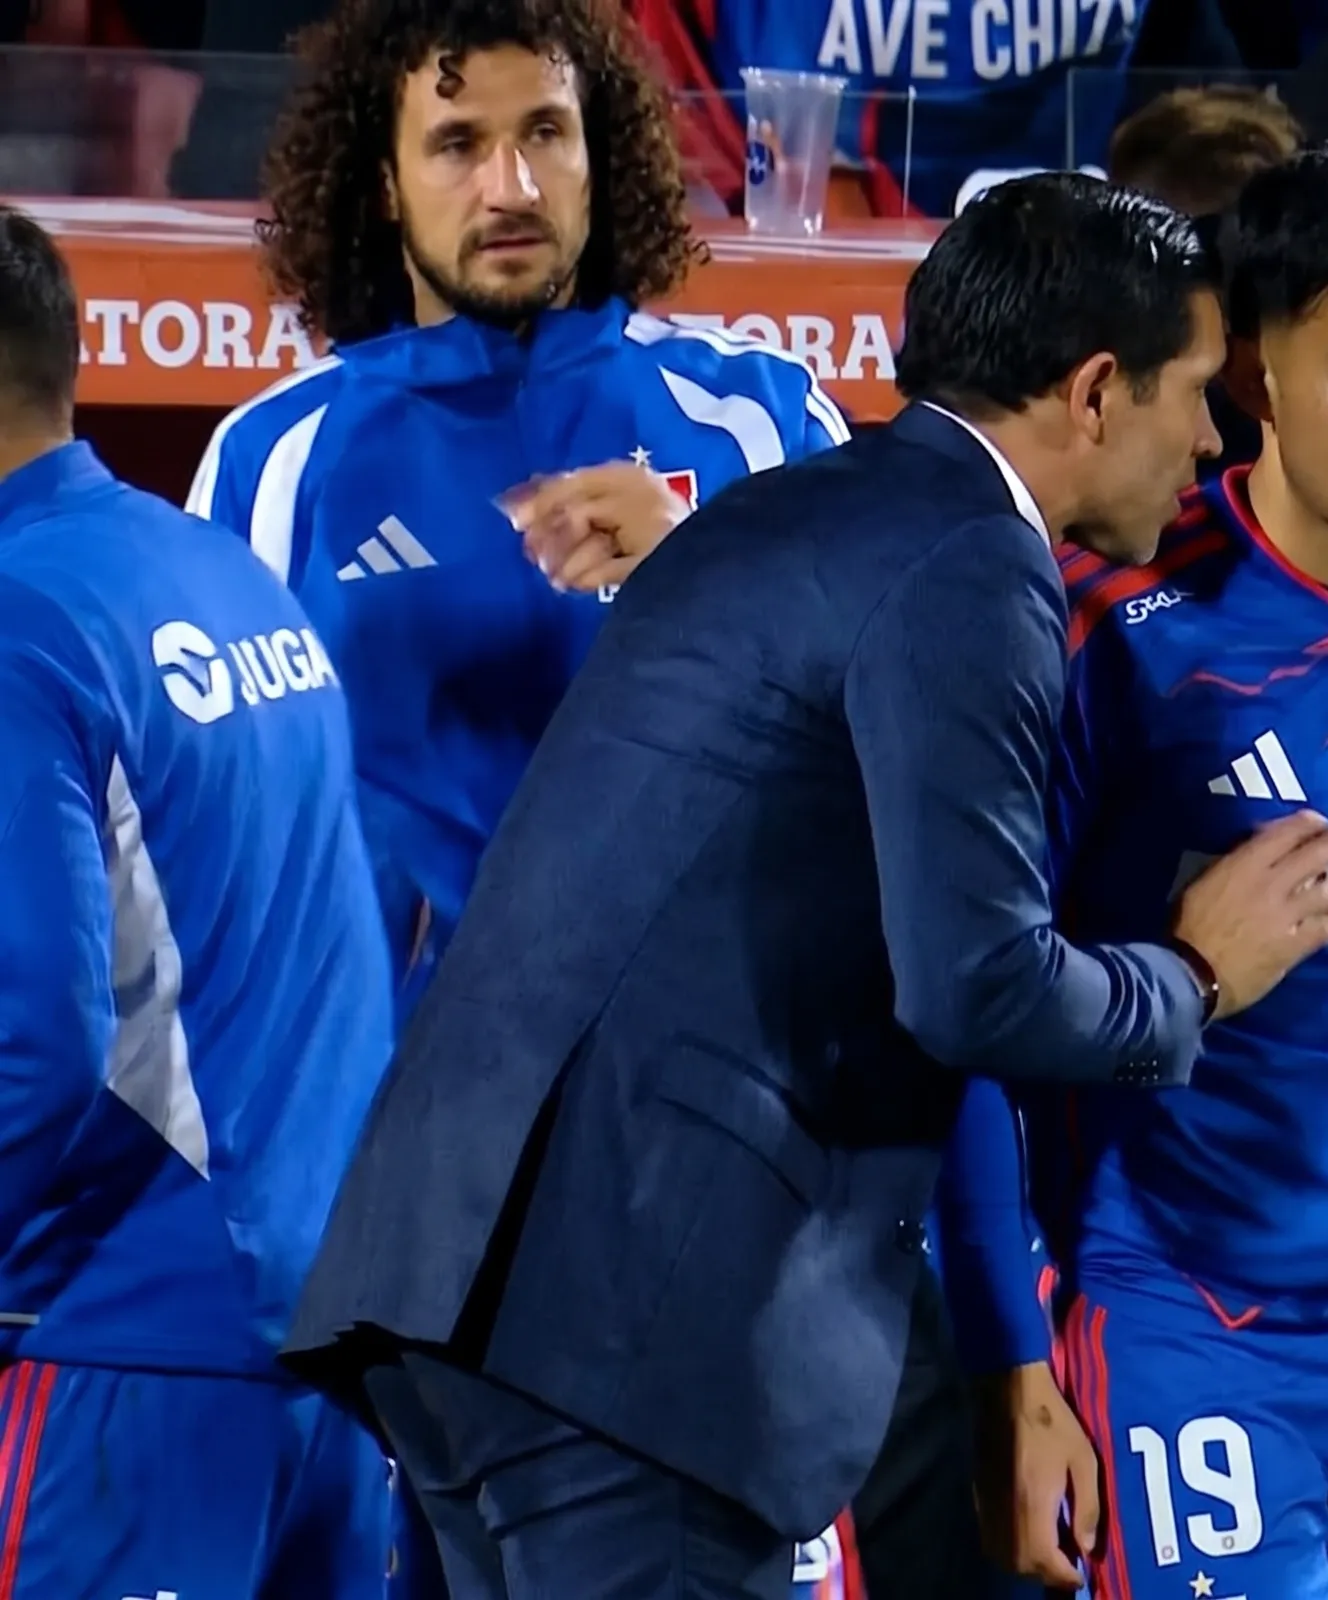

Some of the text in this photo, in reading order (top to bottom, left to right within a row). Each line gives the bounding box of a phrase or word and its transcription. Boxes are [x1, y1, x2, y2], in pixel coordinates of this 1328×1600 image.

[818, 0, 949, 79] AVE
[227, 628, 341, 706] JUGA
[1129, 1416, 1263, 1567] 19
